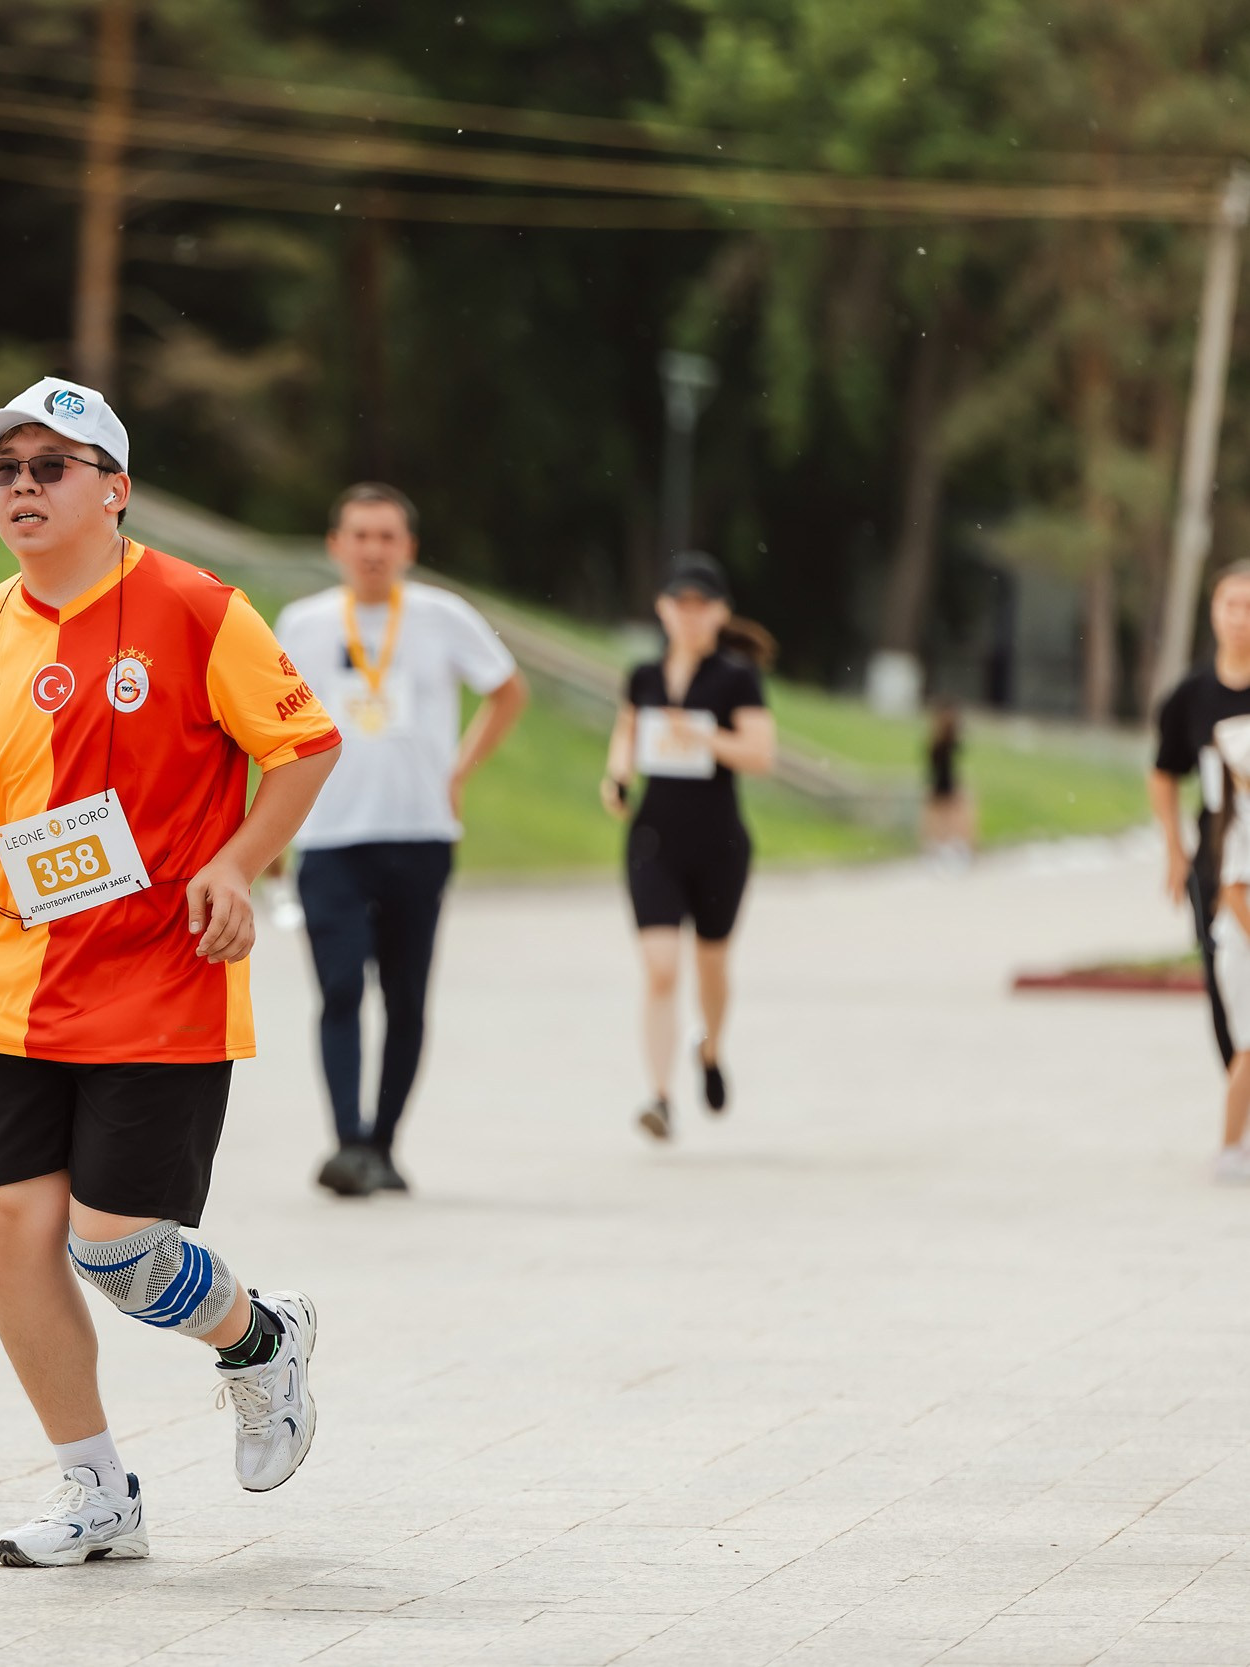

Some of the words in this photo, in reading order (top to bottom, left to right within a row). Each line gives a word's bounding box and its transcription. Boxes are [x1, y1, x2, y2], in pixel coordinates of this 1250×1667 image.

[59, 397, 85, 415] 45
[4, 828, 46, 851] LEONE
[66, 806, 109, 831] D'ORO
[35, 843, 100, 889] 358
[30, 881, 109, 914] БЛАГОТВОРИТЕЛЬНЫЙ
[108, 873, 132, 888] ЗАБЕГ
